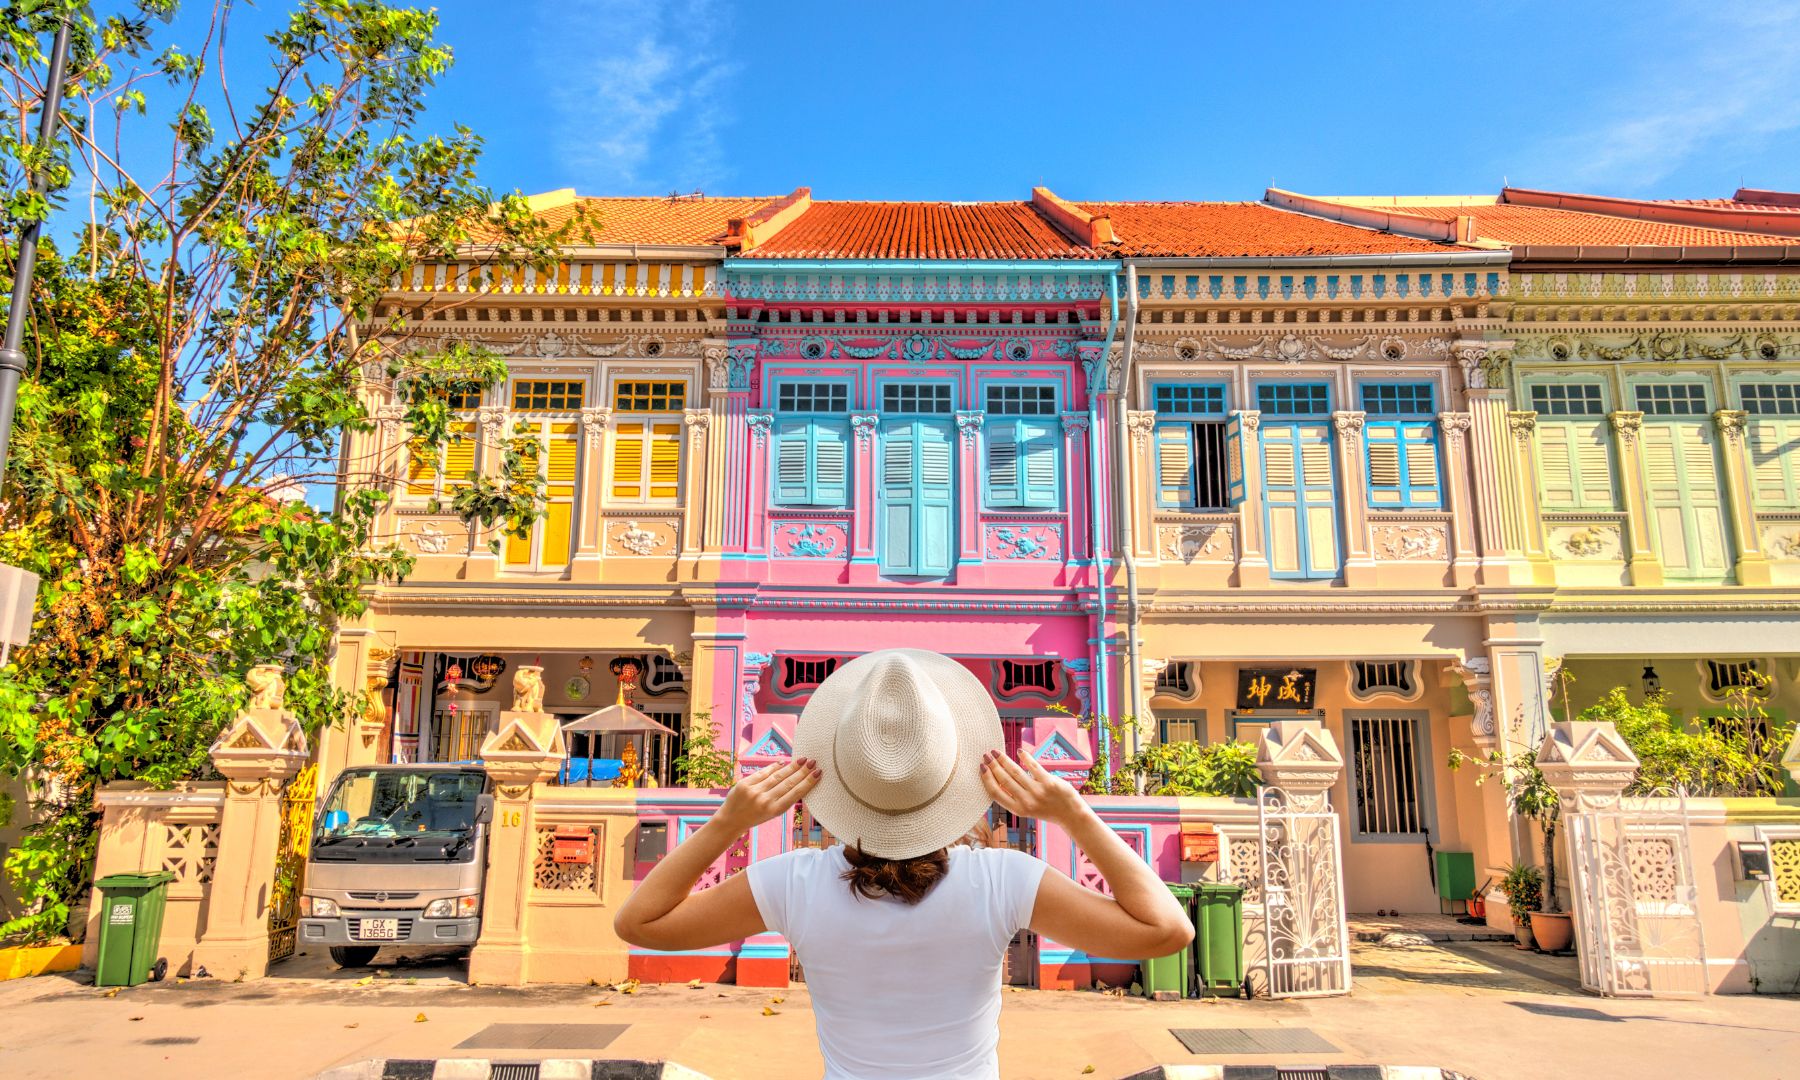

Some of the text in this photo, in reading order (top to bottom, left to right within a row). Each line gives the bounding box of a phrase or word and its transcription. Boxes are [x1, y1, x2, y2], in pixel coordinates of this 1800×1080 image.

[502, 811, 521, 828] 16
[372, 919, 386, 929] GX
[363, 928, 394, 938] 1365G
